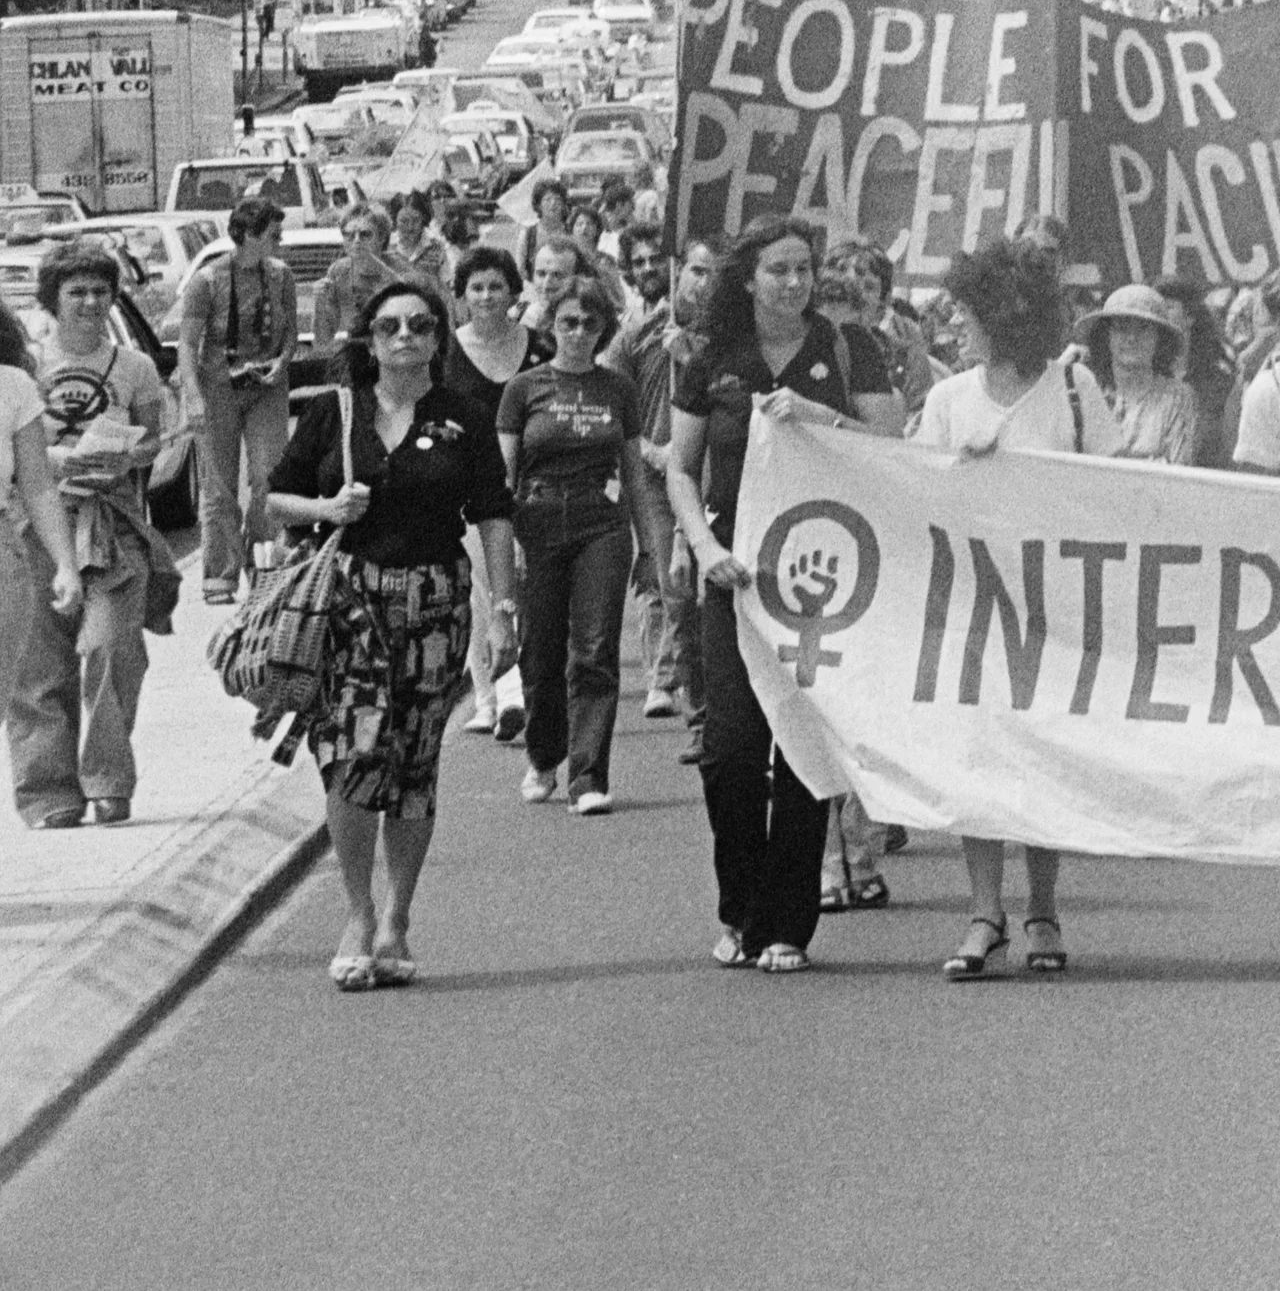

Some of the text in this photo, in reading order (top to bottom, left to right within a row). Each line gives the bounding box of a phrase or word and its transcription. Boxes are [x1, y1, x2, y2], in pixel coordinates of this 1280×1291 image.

[35, 79, 149, 95] MEAT CO
[1080, 16, 1237, 127] FOR
